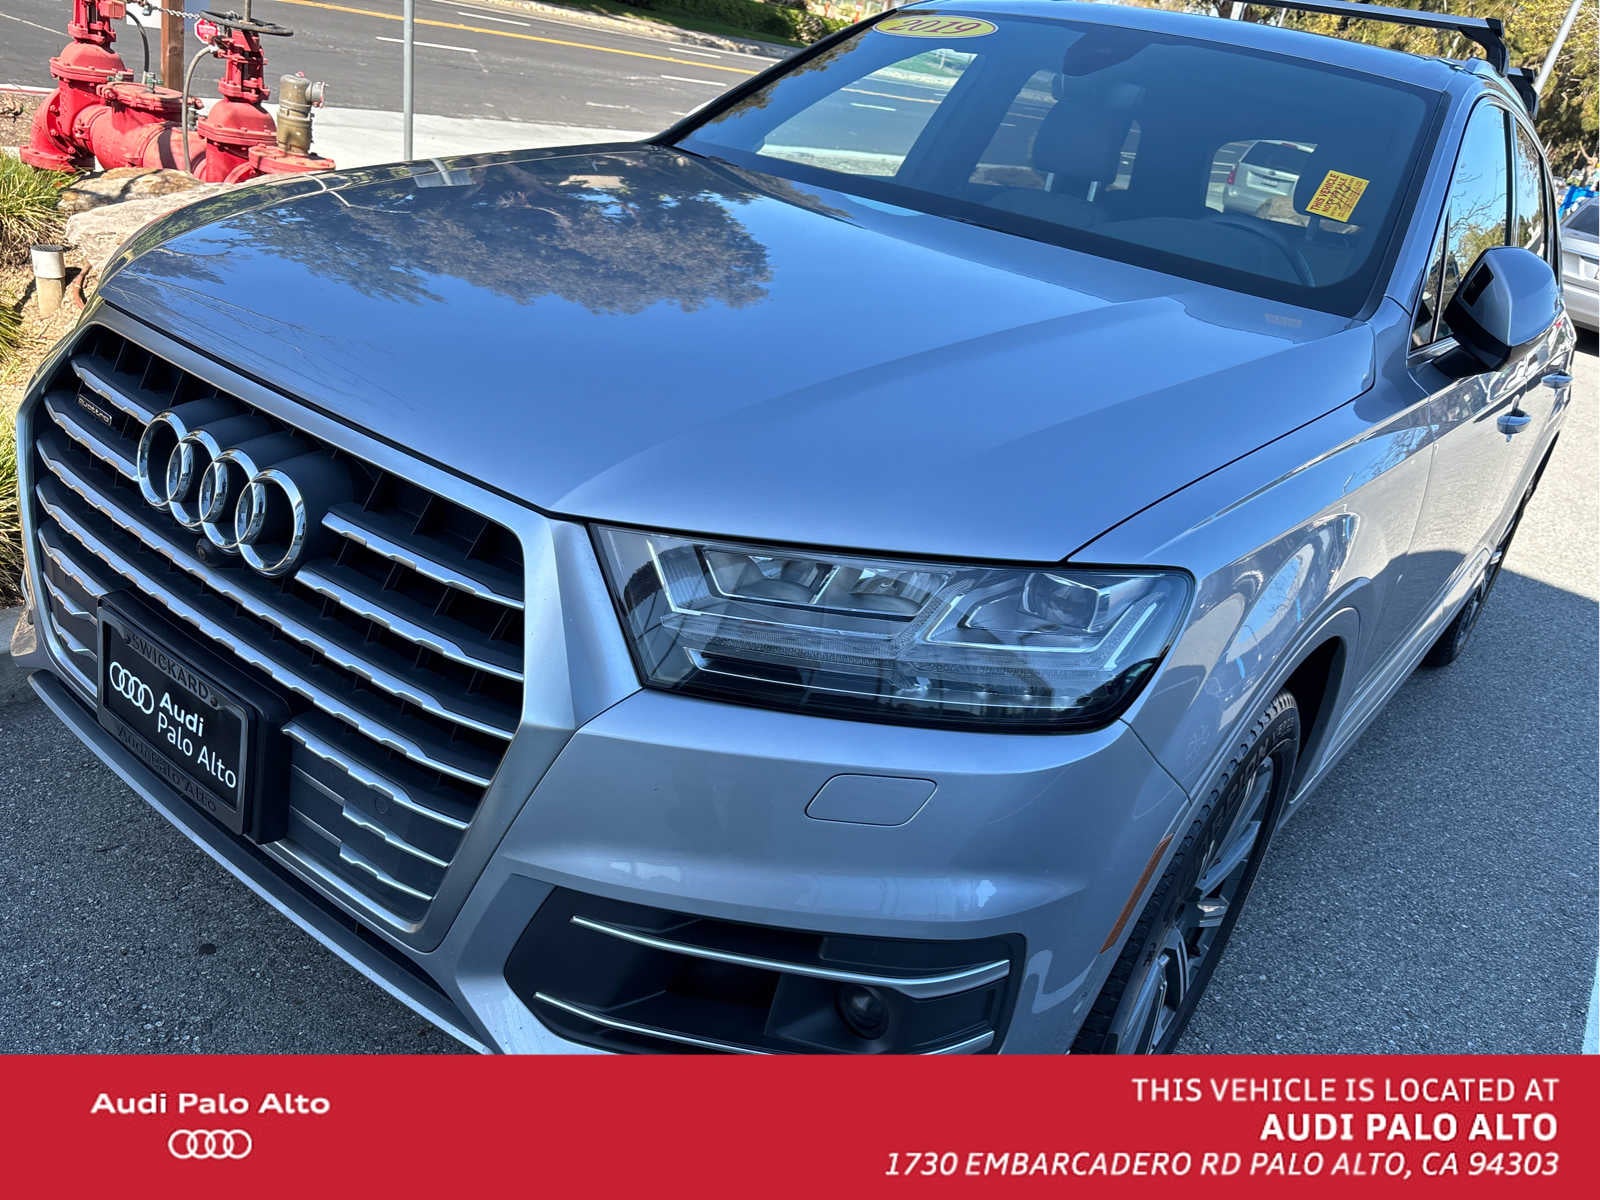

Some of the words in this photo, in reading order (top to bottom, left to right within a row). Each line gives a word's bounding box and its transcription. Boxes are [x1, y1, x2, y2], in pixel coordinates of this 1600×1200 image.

[888, 19, 981, 34] 2019
[1309, 196, 1324, 211] THIS
[1320, 173, 1339, 197] VEHICLE
[131, 633, 209, 699] SWICKARD
[159, 692, 204, 737] Audi
[157, 711, 193, 756] Palo
[197, 746, 237, 789] Alto
